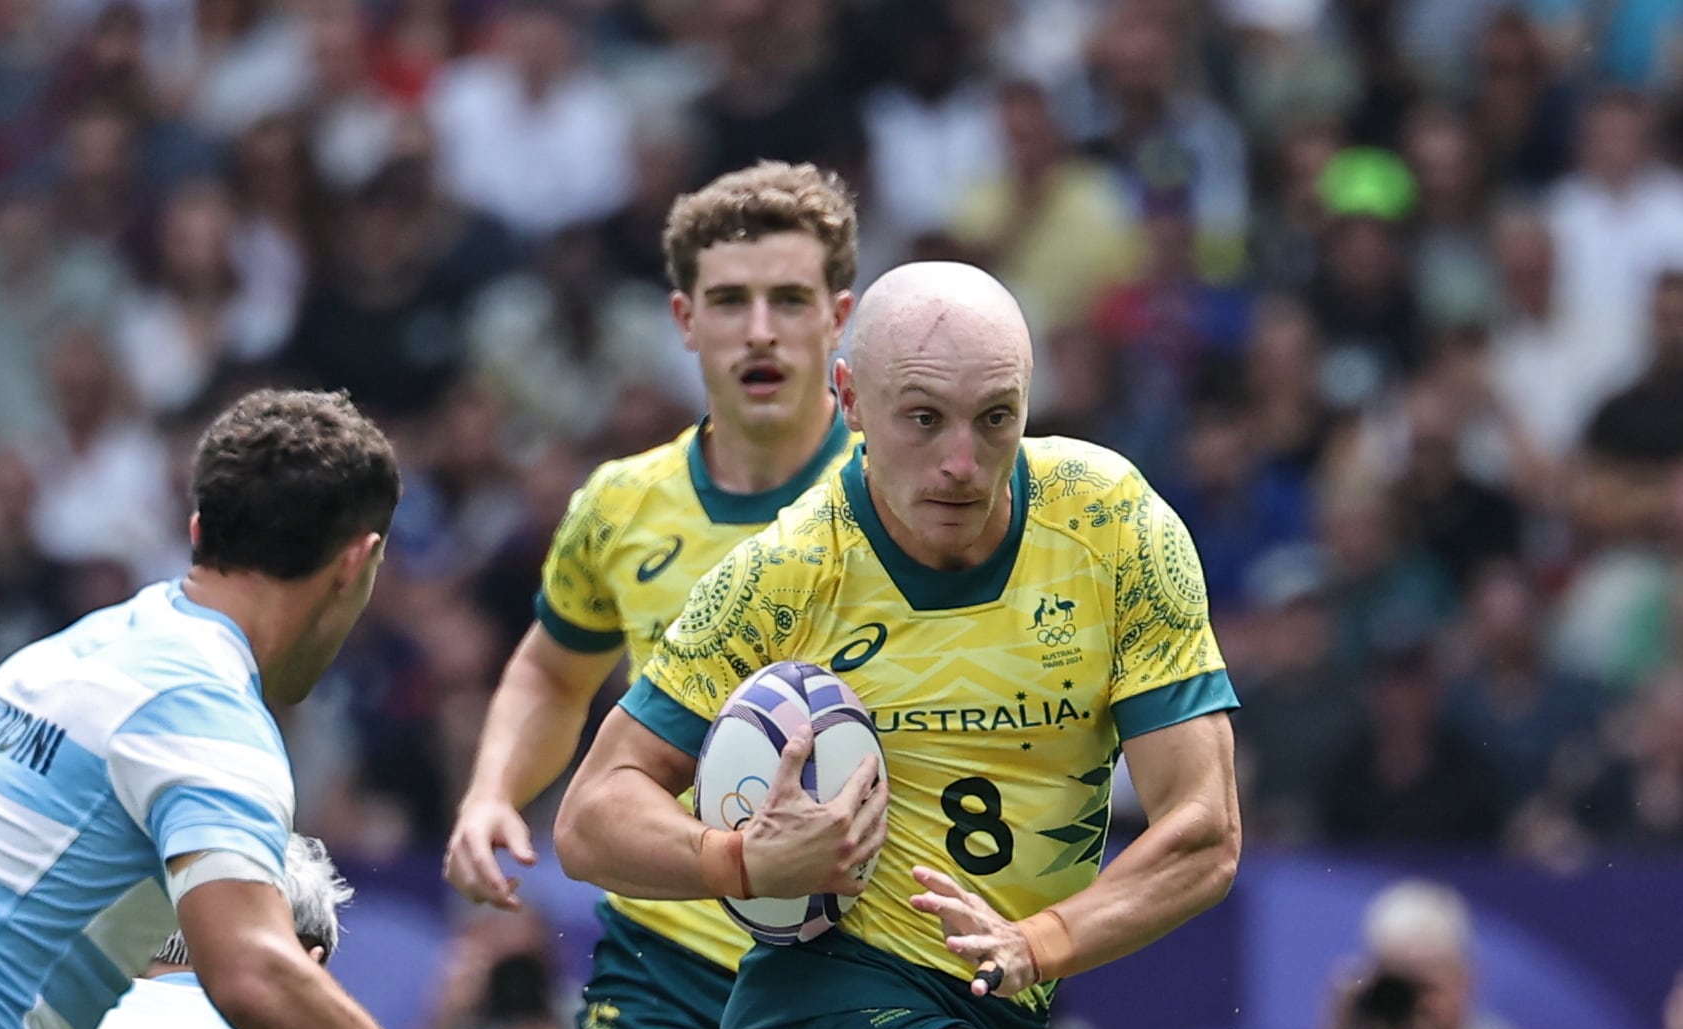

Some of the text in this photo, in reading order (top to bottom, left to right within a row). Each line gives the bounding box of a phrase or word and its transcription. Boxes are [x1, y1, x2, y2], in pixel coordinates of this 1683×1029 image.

[1041, 647, 1082, 661] AUSTRALIA
[869, 698, 1080, 733] USTRALIA
[941, 777, 1014, 875] 8
